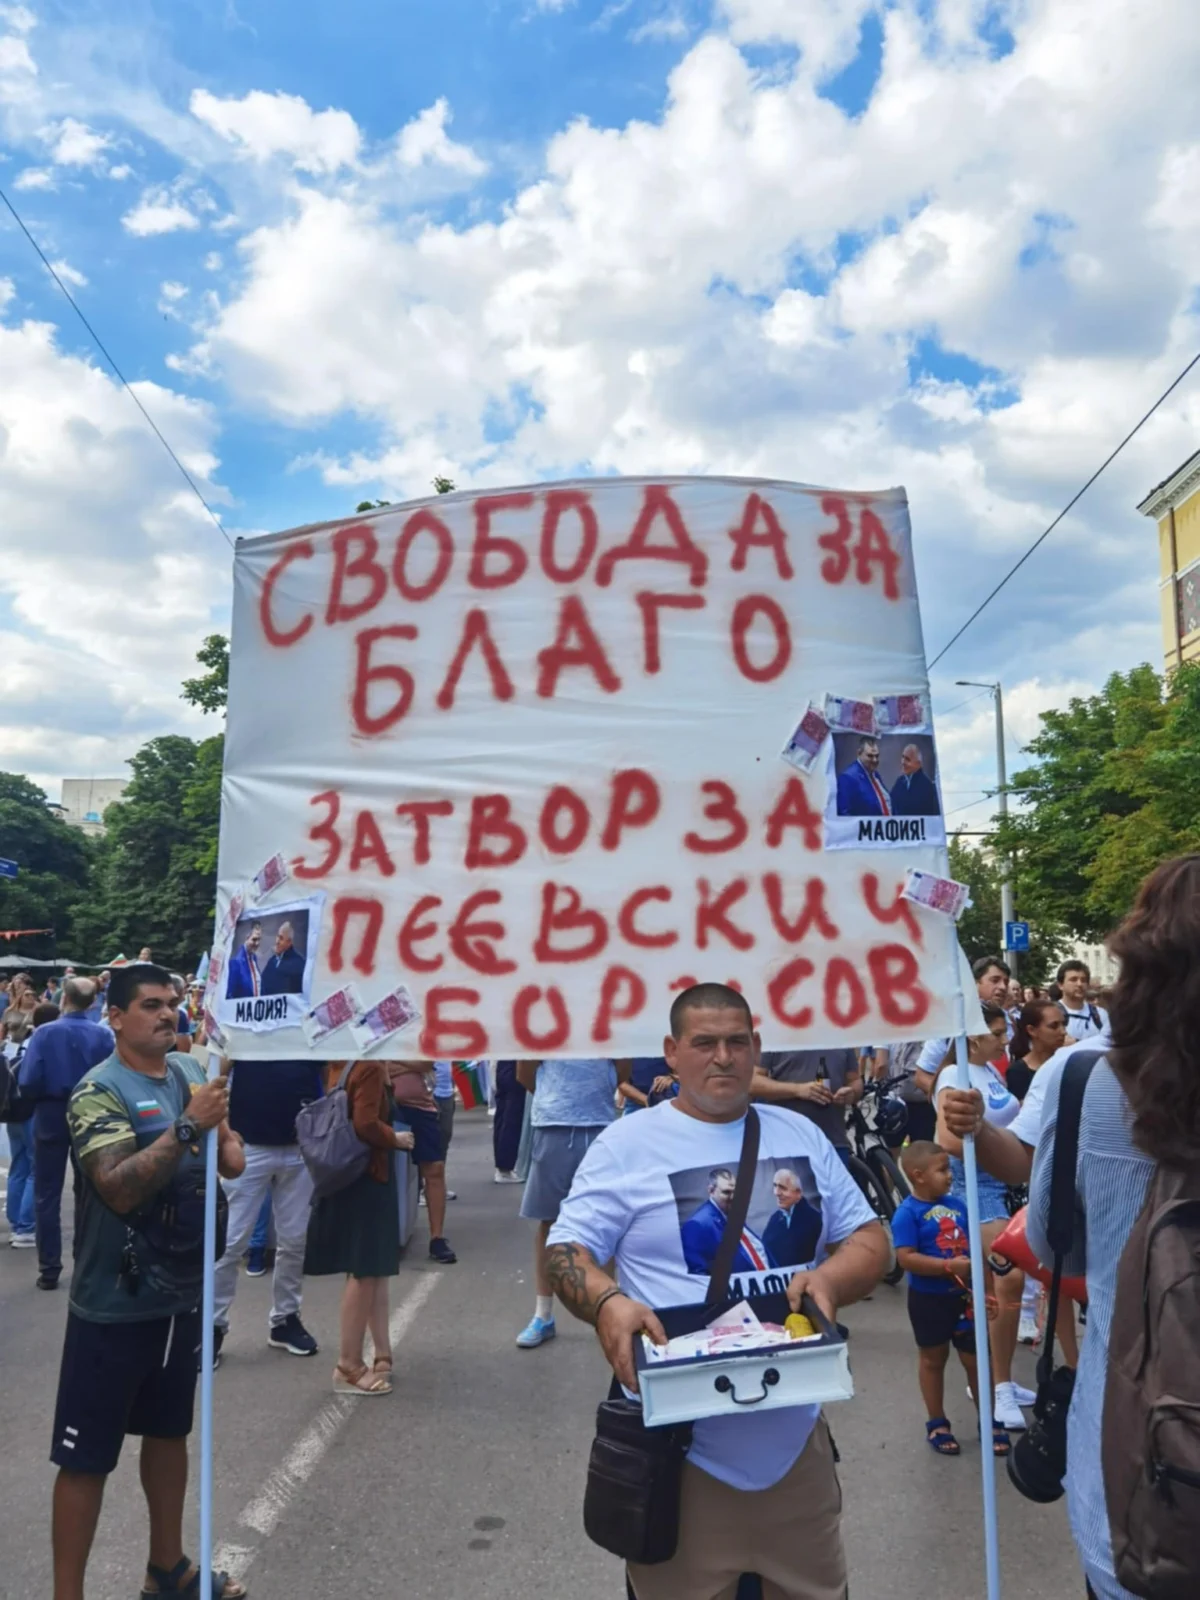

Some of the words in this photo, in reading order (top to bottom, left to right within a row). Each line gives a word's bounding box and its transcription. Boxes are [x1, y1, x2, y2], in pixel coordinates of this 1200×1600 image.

[260, 484, 794, 647] СВОБОДА
[818, 493, 899, 601] ЗА
[351, 592, 792, 736] БЛАГО
[292, 768, 660, 880] ЗАТВОР
[682, 775, 822, 855] ЗА
[857, 818, 927, 842] МАФИЯ!
[1012, 926, 1024, 943] P
[235, 996, 288, 1023] МАФИЯ!
[419, 943, 933, 1059] БОРСОВ
